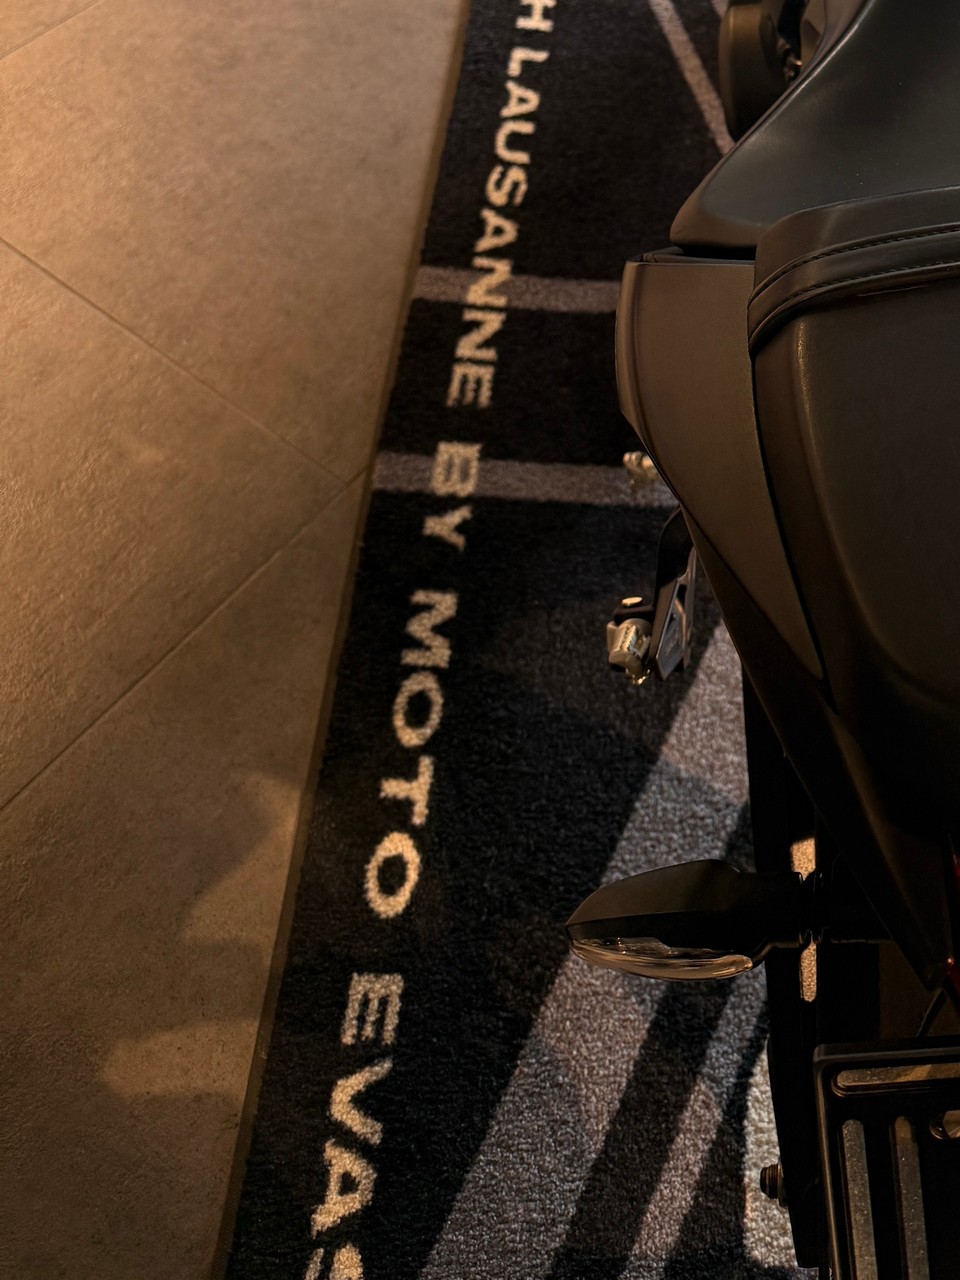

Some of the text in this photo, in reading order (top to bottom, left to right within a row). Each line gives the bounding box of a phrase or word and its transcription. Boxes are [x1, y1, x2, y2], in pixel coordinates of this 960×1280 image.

[445, 49, 550, 410] LAUSANNE
[422, 440, 482, 553] BY
[363, 588, 459, 920] MOTO
